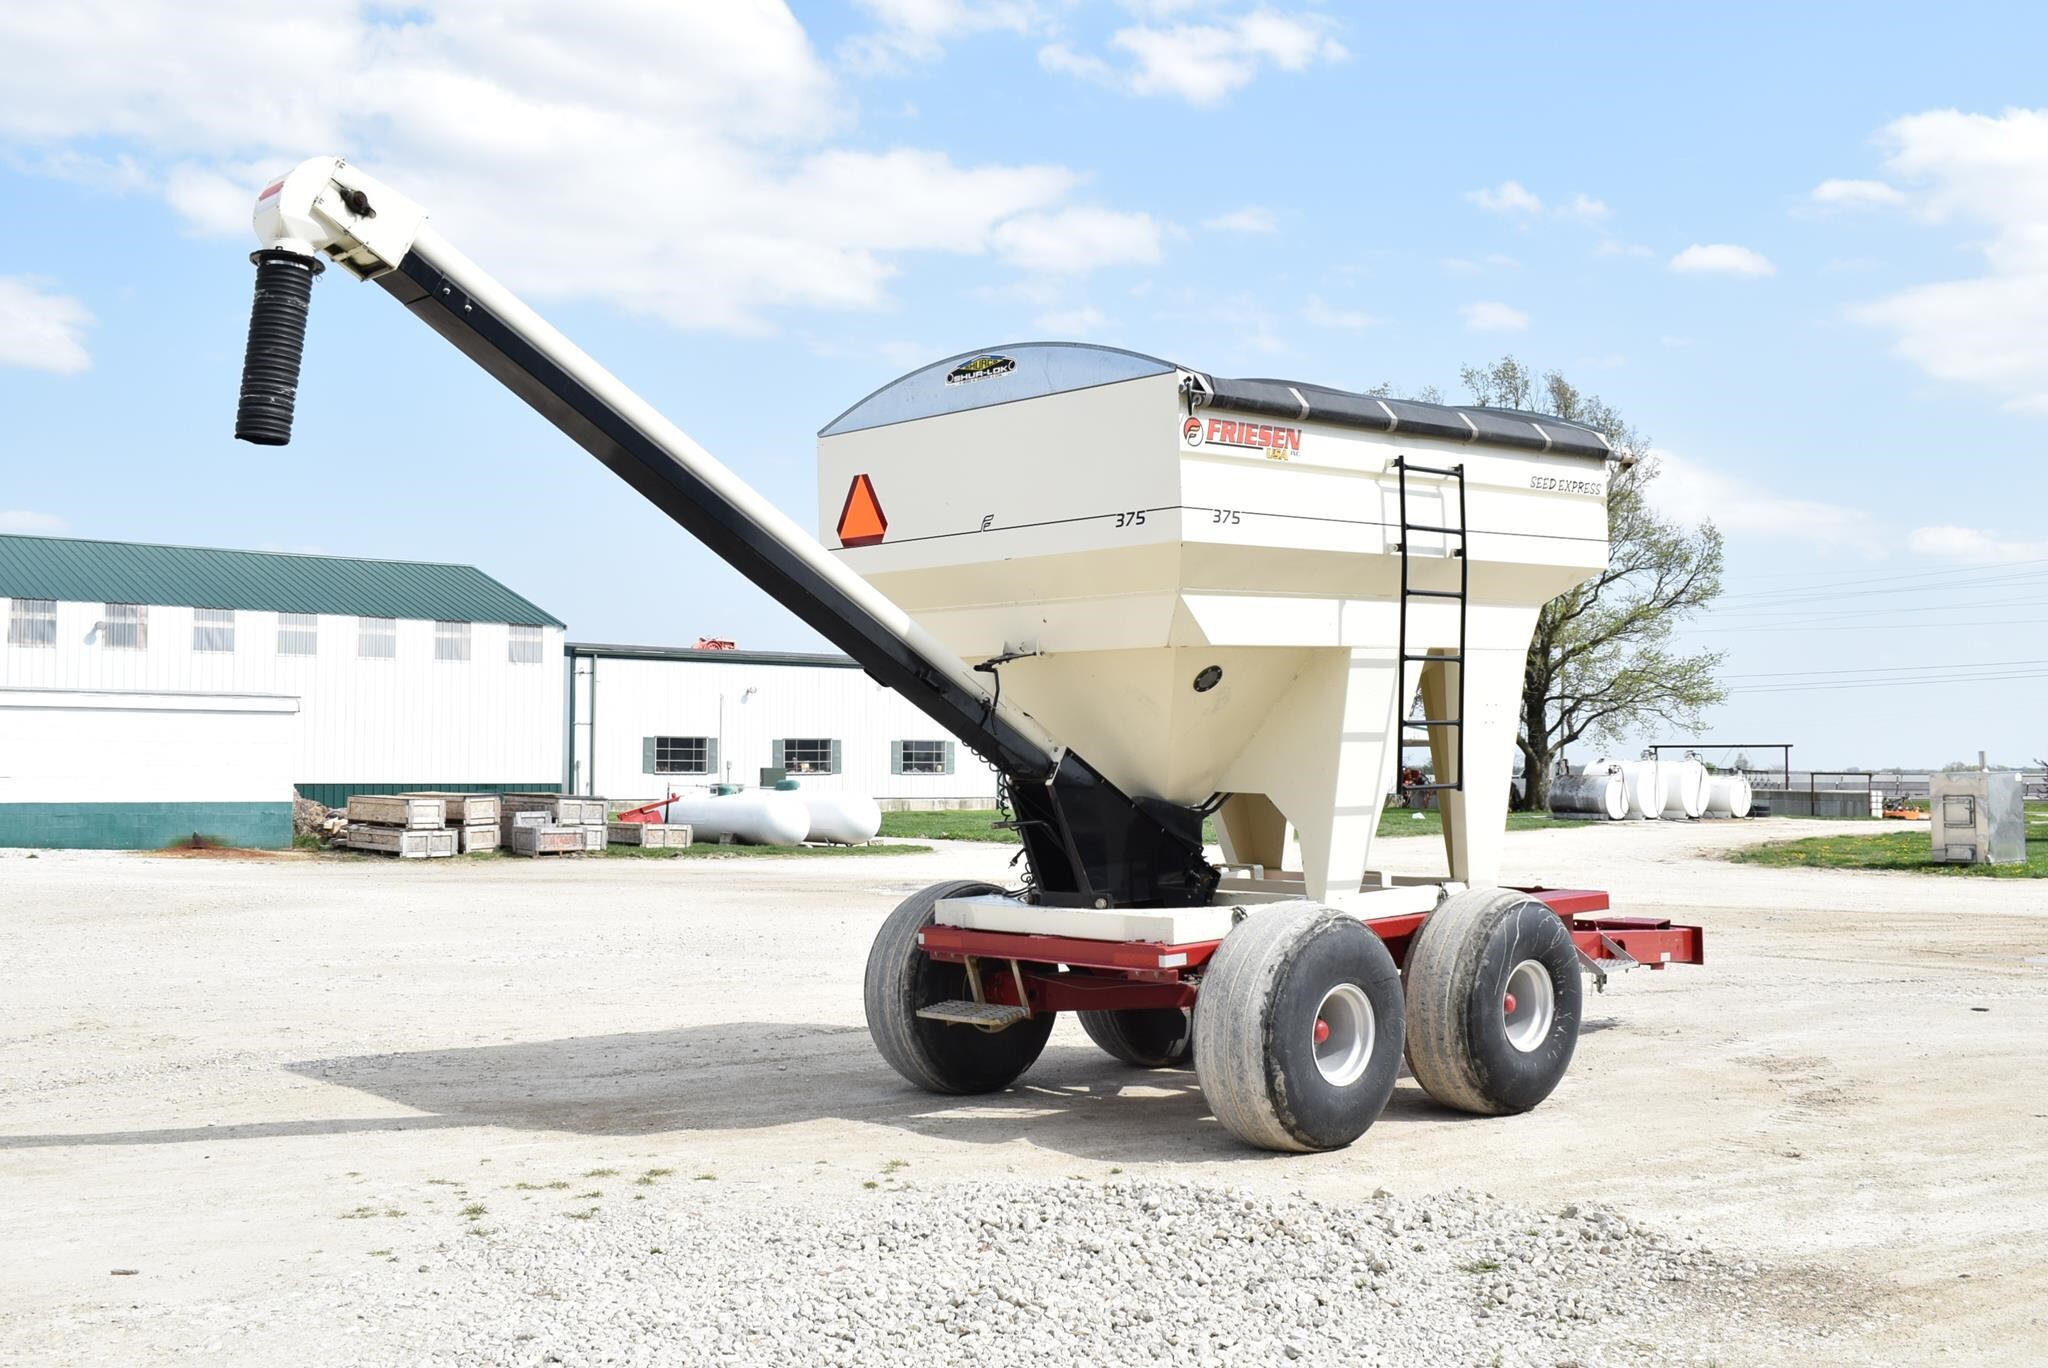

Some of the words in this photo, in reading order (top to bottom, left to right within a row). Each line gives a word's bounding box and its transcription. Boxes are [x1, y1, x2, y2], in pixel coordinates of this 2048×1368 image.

[953, 365, 1009, 382] SHUR-LOK
[1206, 418, 1303, 451] FRIESEN
[1266, 448, 1289, 461] USA
[1530, 475, 1557, 490] SEED
[1558, 479, 1602, 495] EXPRESS
[1115, 510, 1146, 528] 375
[1213, 509, 1241, 525] 375
